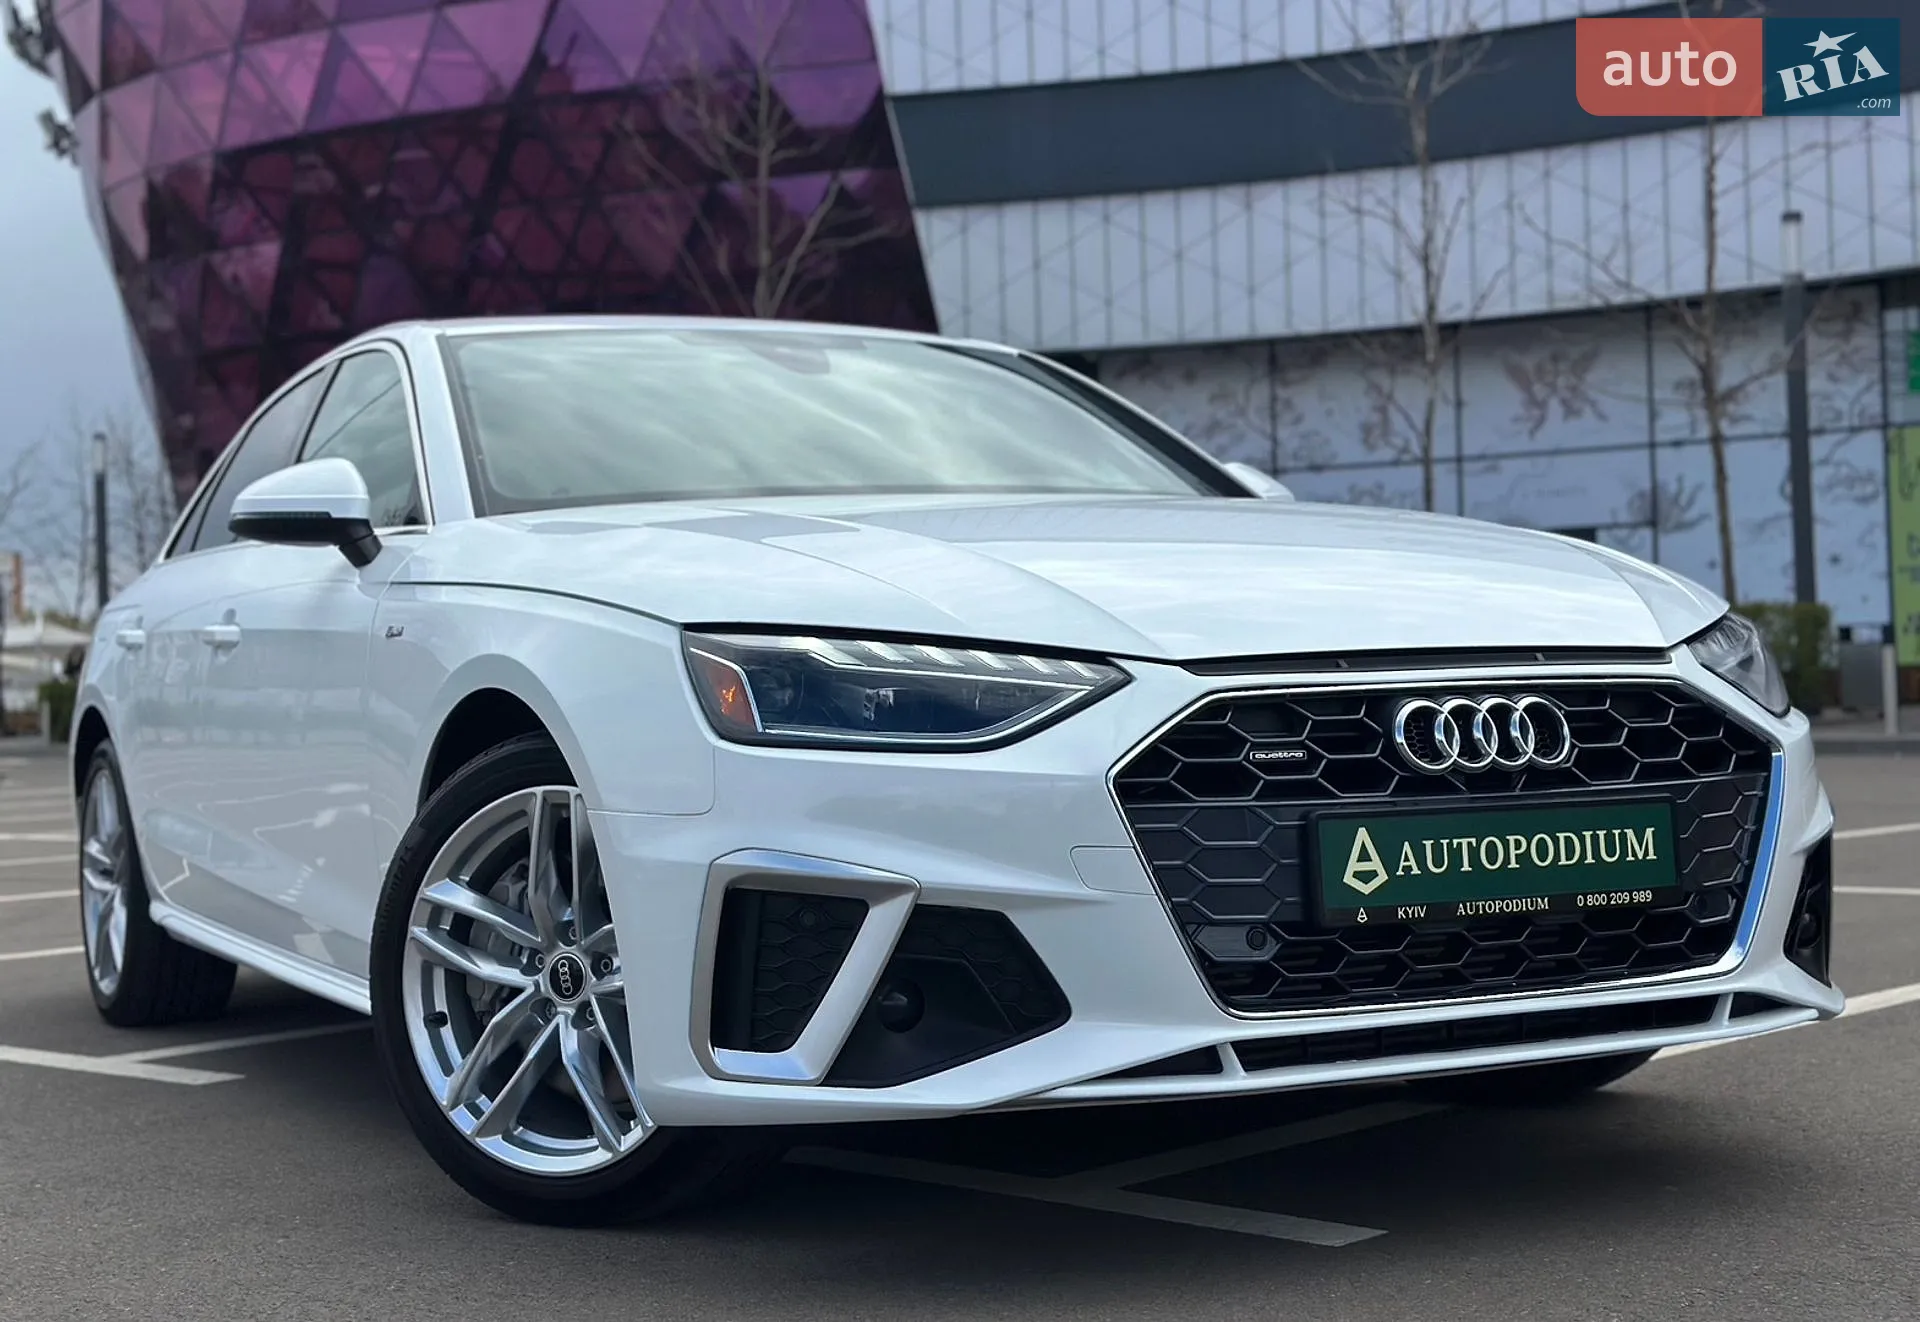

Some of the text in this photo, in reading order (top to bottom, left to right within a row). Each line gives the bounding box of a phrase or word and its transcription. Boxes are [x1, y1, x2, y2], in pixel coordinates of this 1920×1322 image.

[1396, 827, 1657, 876] AUTOPODIUM
[1397, 889, 1653, 920] KYIV AUTOPODIUM 0 800 209 989
